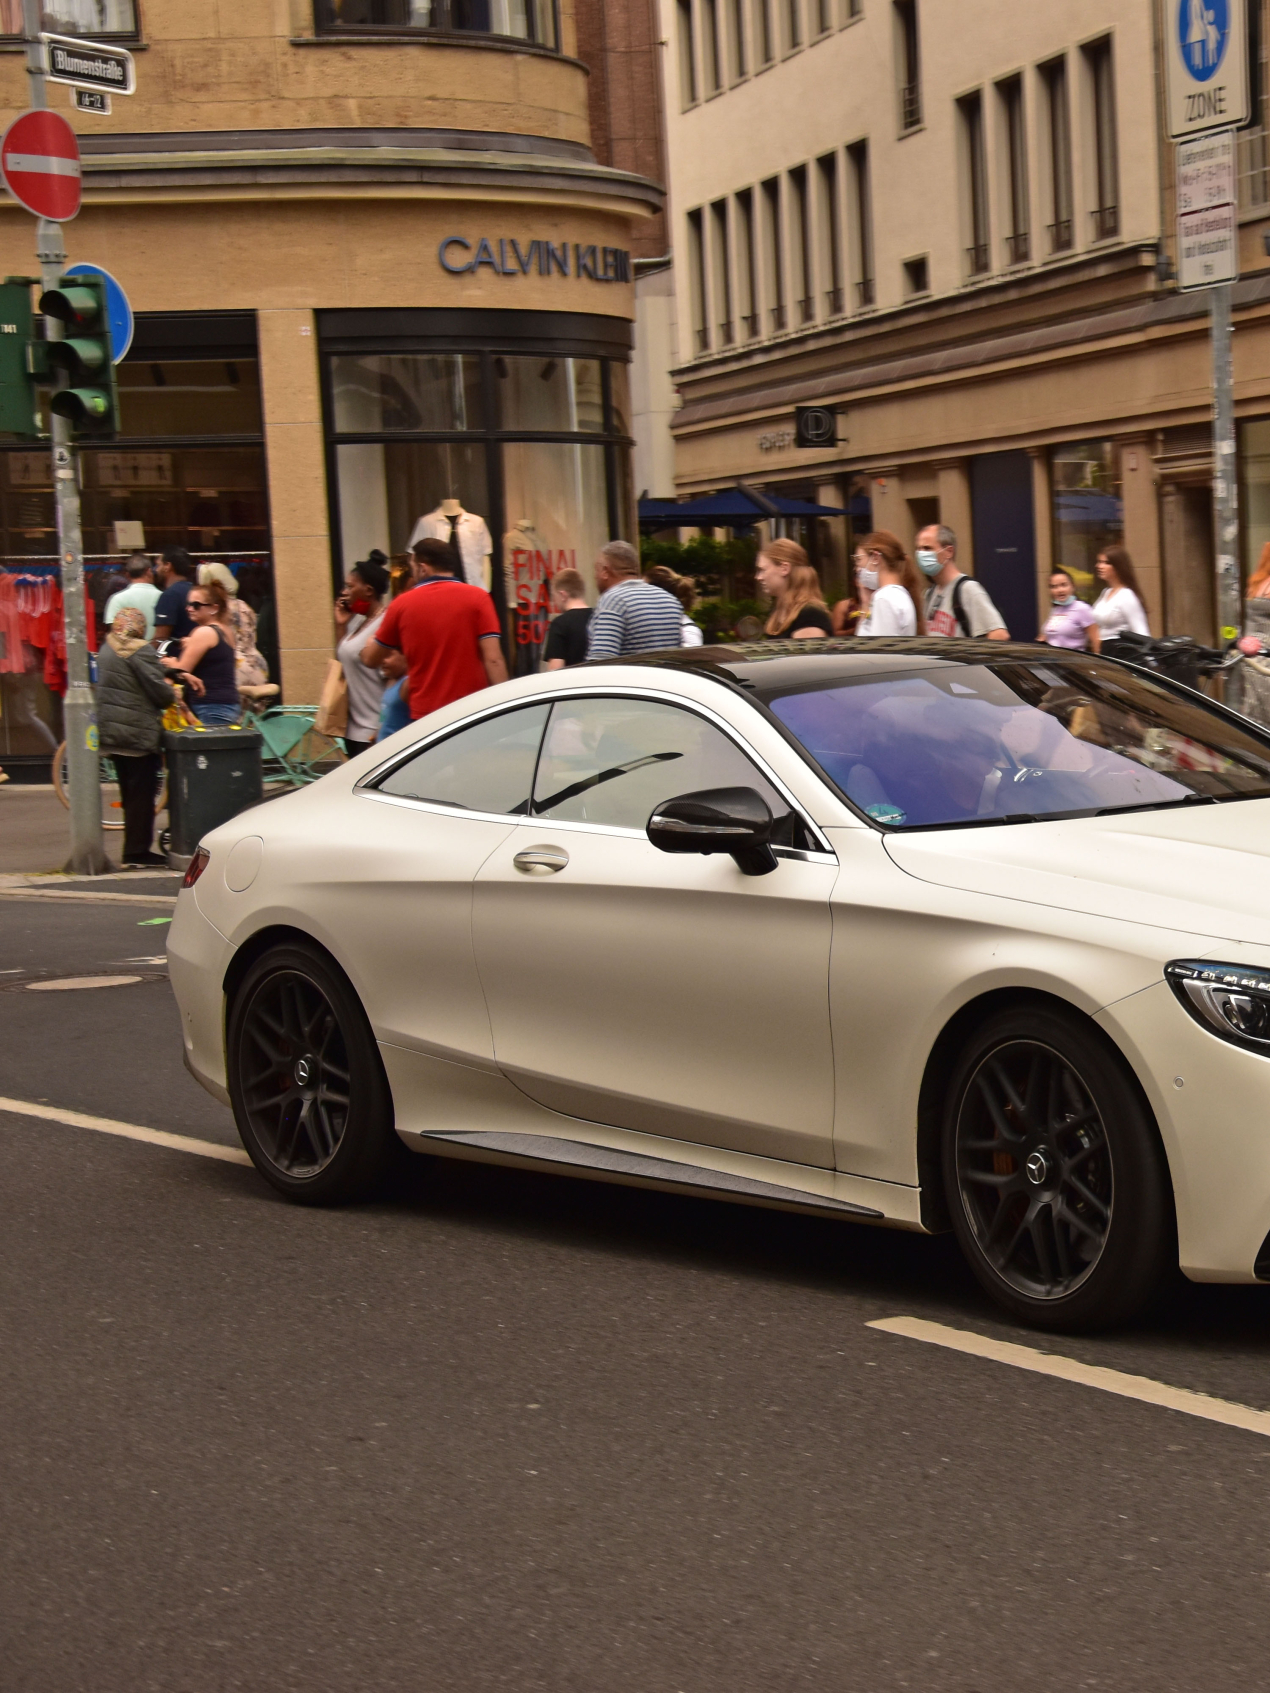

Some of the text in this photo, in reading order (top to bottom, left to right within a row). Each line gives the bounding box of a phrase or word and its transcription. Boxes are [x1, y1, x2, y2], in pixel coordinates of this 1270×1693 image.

[54, 50, 124, 81] Blumenstraße
[1185, 86, 1227, 122] ZONE
[438, 235, 632, 283] CALVIN KLEIN
